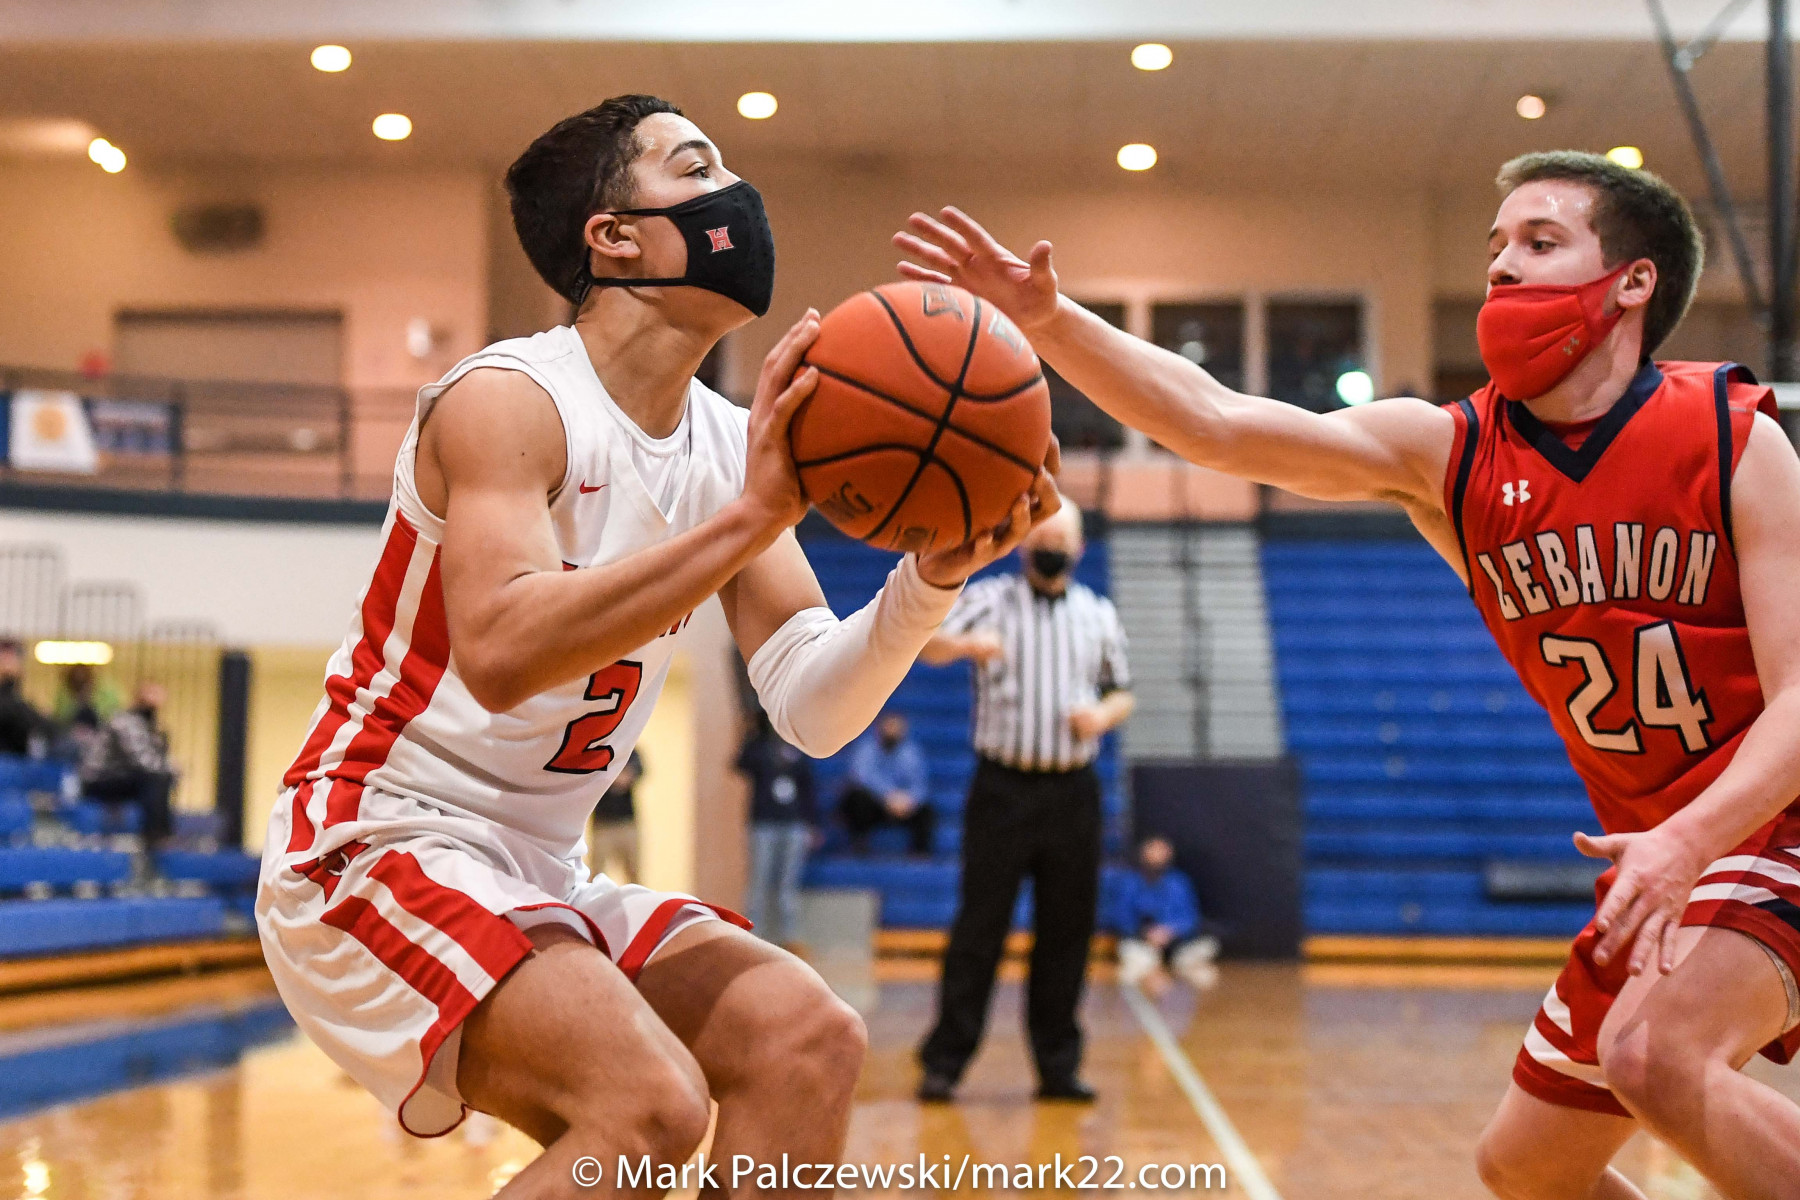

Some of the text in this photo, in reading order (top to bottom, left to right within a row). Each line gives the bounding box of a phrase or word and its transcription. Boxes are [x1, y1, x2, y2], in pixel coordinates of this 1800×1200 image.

[705, 225, 735, 253] H
[1476, 521, 1717, 621] LEBANON
[543, 659, 643, 774] 2
[1538, 619, 1715, 756] 24
